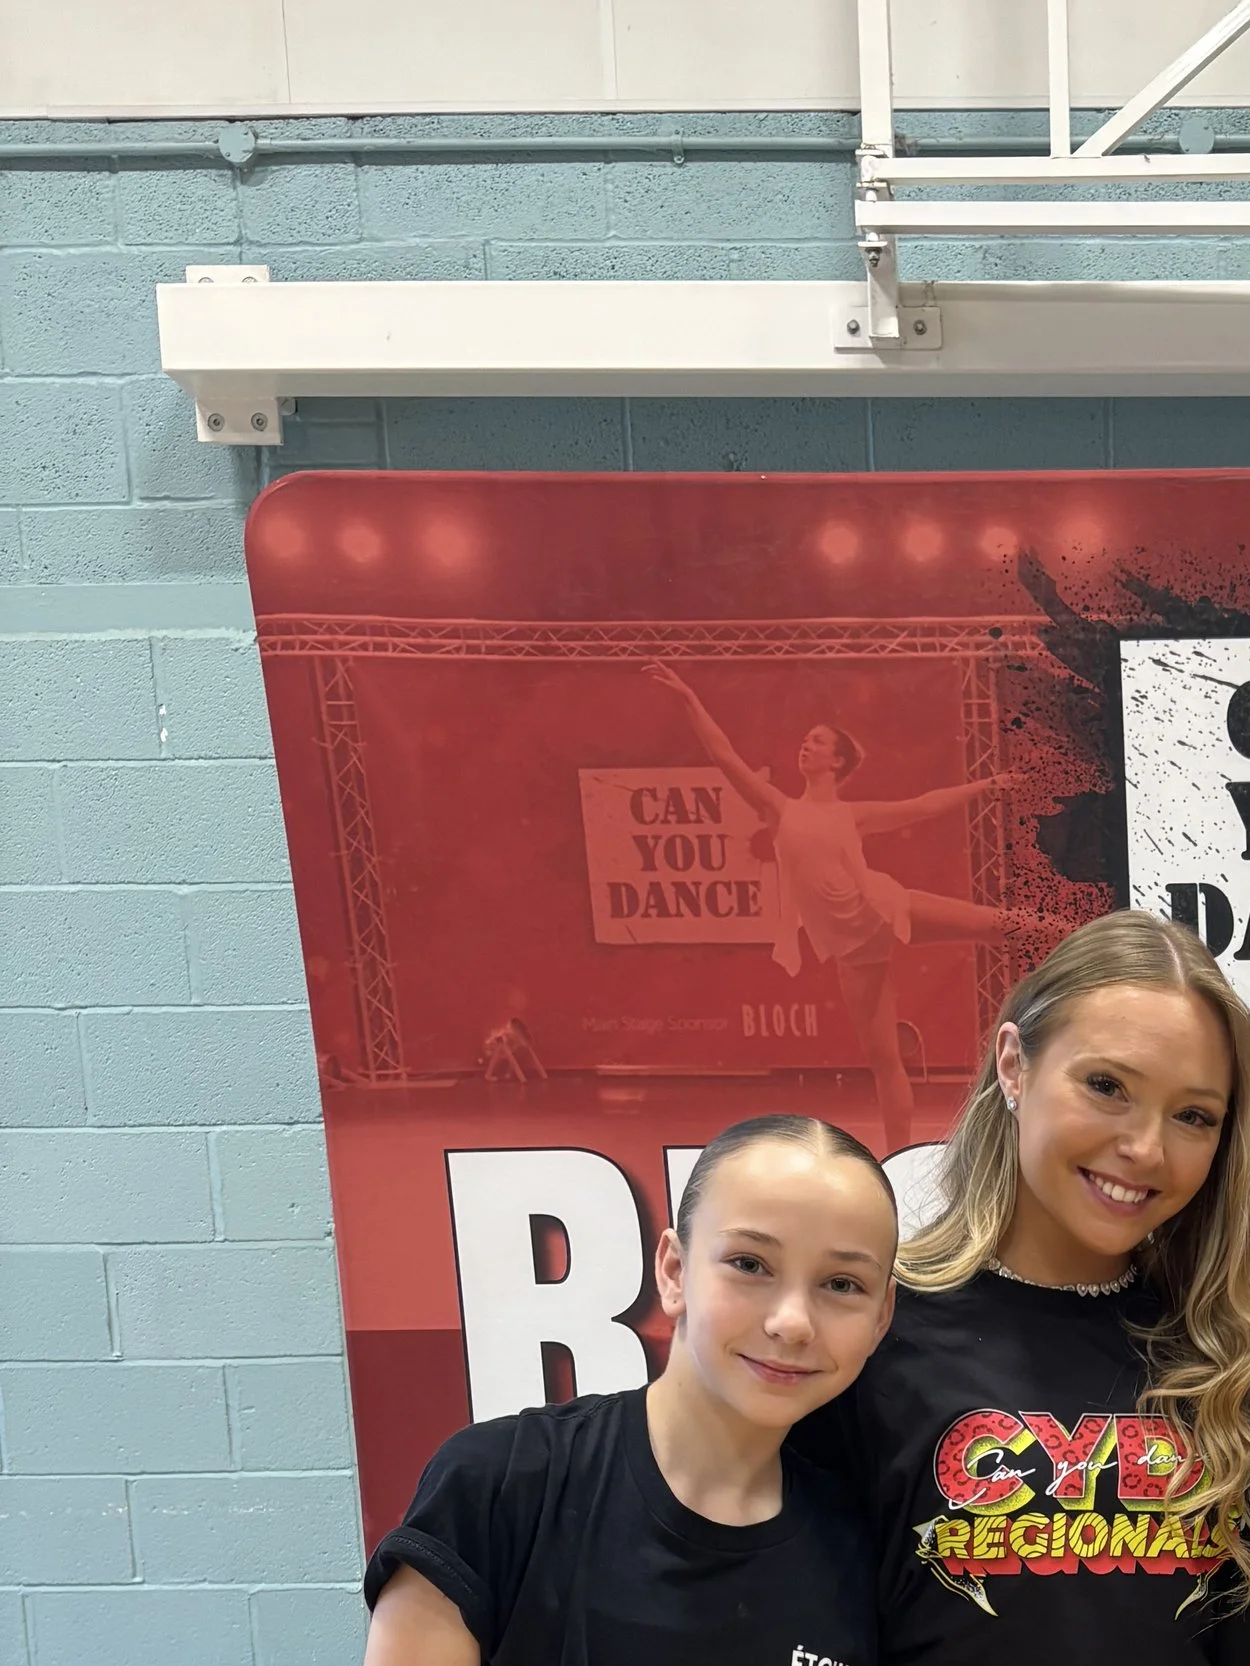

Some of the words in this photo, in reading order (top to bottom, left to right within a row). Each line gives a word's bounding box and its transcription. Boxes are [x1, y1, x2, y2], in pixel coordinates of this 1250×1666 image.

[630, 786, 723, 826] CAN
[632, 833, 730, 873] YOU
[606, 879, 762, 919] DANCE
[741, 1003, 819, 1038] BLOCH
[933, 1408, 1210, 1510] CYD
[948, 1449, 1037, 1510] Can
[1045, 1459, 1118, 1497] you
